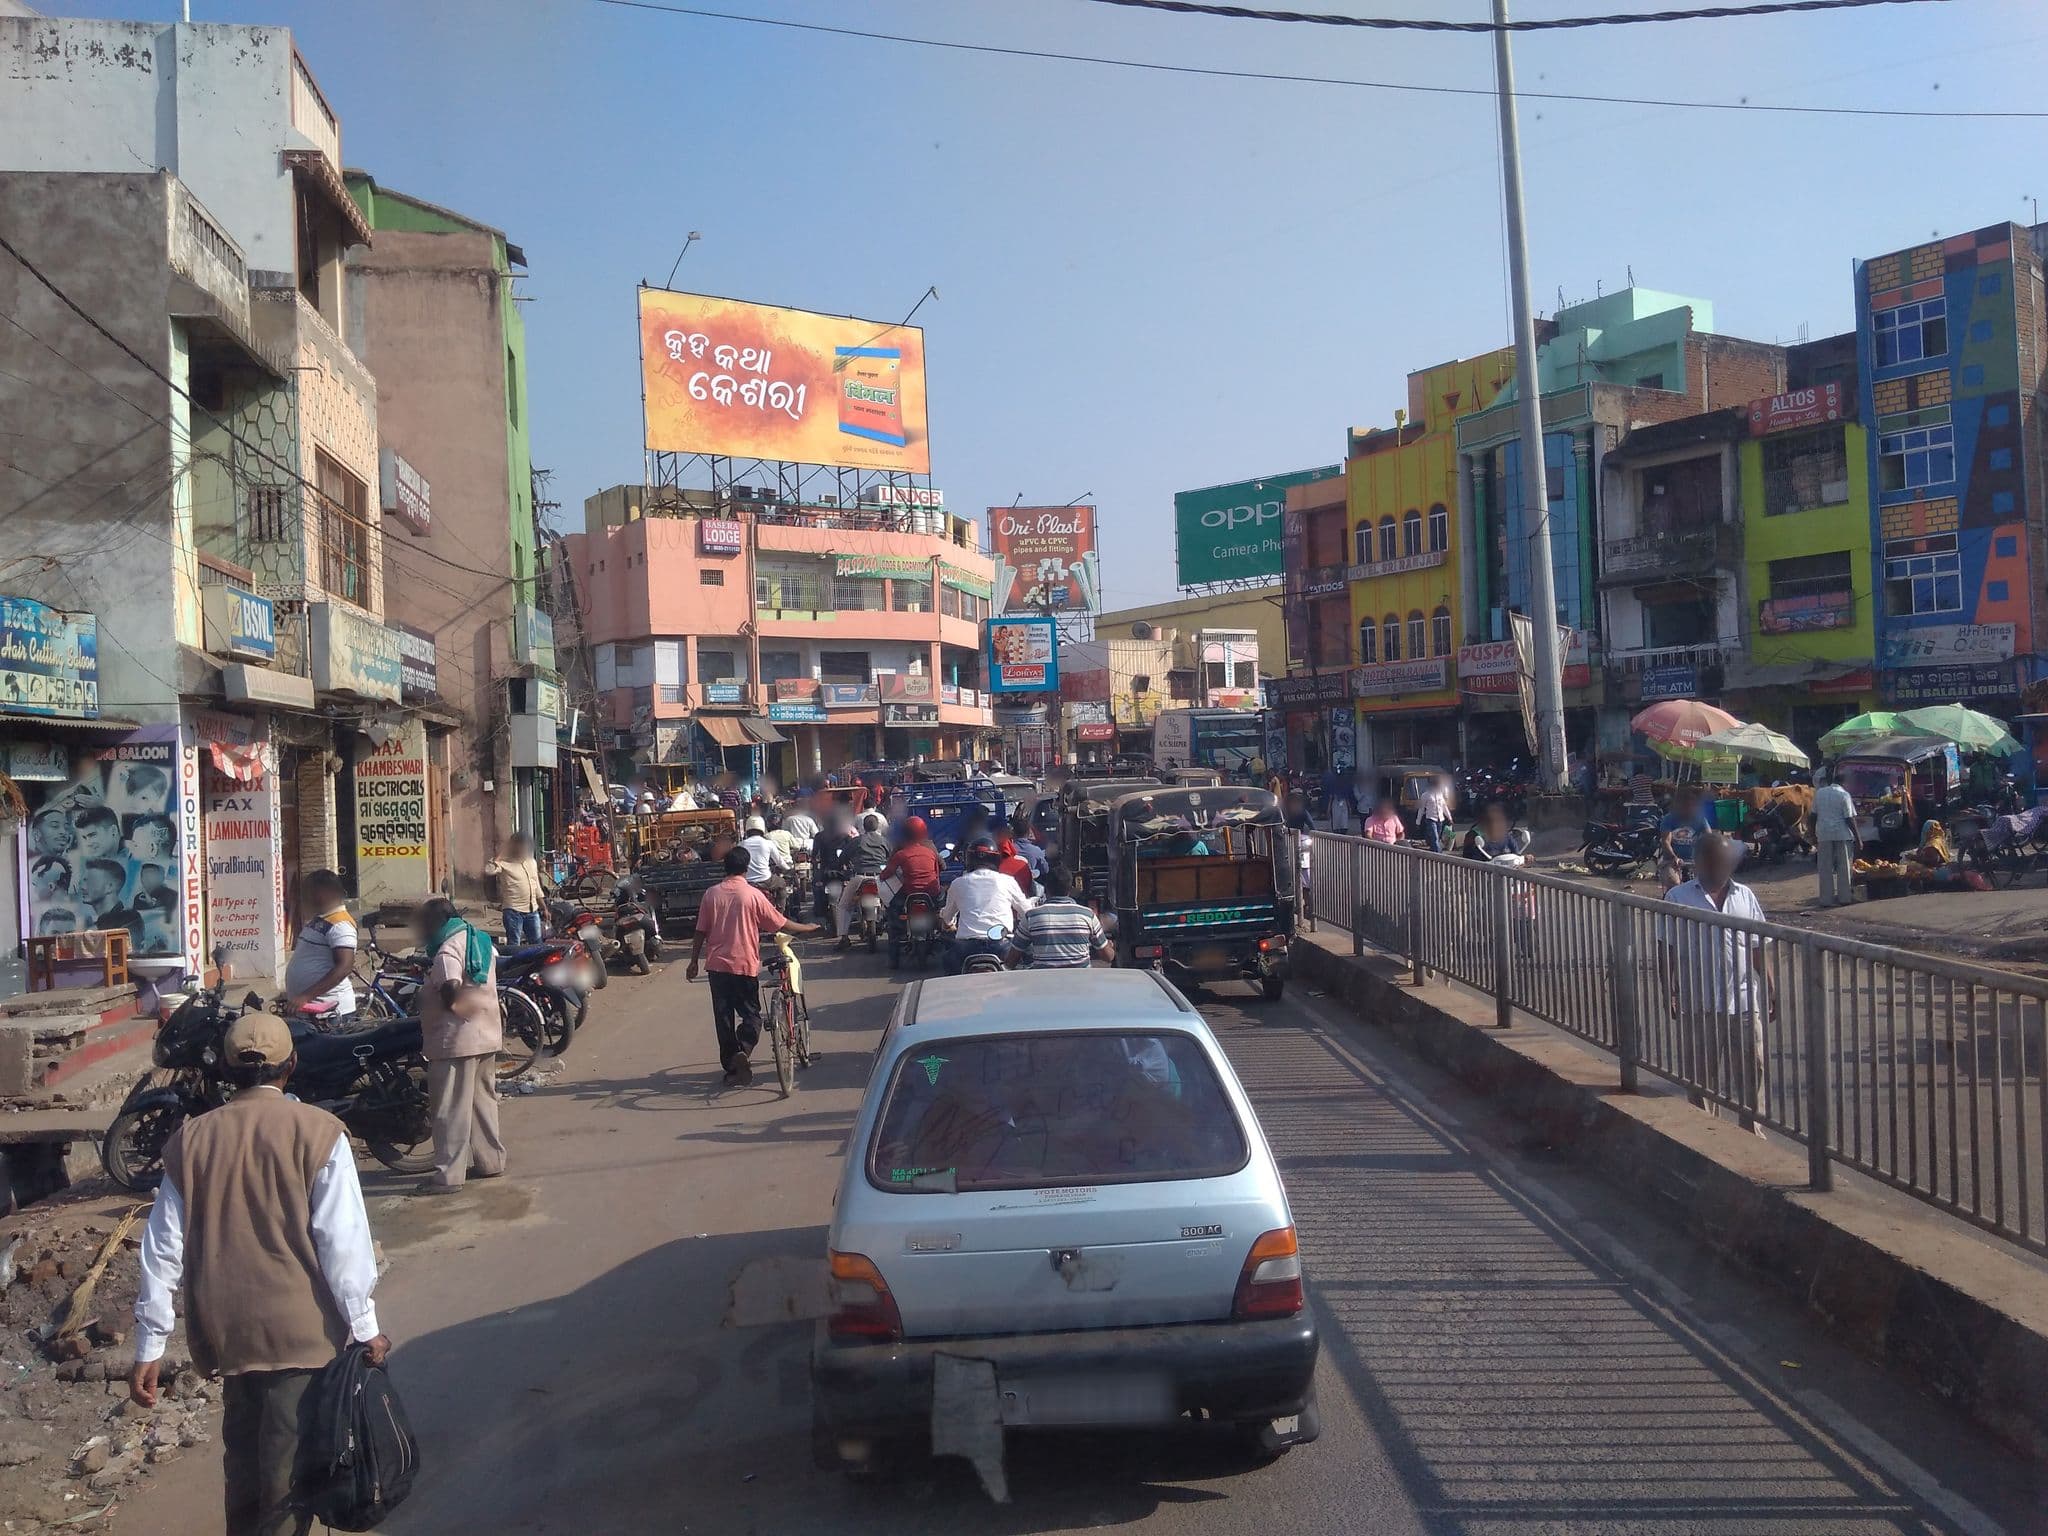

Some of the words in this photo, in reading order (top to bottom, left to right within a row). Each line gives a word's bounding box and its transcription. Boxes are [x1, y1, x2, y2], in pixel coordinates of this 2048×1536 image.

[714, 345, 771, 375] କଥା
[688, 372, 806, 420] କେଶରୀ
[1771, 389, 1815, 412] ALTOS
[881, 487, 941, 504] LODGE
[1201, 501, 1284, 529] opp
[705, 529, 740, 544] LODGE
[1048, 537, 1068, 545] CPVC
[1013, 546, 1033, 555] pipes
[1034, 545, 1048, 553] and
[1049, 545, 1074, 554] fittings
[1212, 542, 1258, 559] Camera
[1309, 581, 1344, 594] TATTOOS
[242, 598, 272, 643] BSNL
[1, 632, 27, 660] Hair
[29, 637, 64, 677] Cutting
[66, 645, 96, 670] Saloon
[1476, 660, 1511, 669] LODGING
[1470, 675, 1497, 689] HOTEL
[1669, 681, 1692, 693] ATM
[1897, 688, 1919, 699] SRI
[1972, 683, 2016, 696] LODGE
[118, 746, 169, 760] SALOON
[356, 760, 424, 777] KHAMBESWARI
[210, 777, 264, 793] XEROX
[358, 780, 424, 798] ELECTRICALS
[183, 745, 197, 850] COLOUR
[213, 799, 253, 812] FAX
[208, 820, 271, 841] LAMINATION
[362, 846, 421, 857] XEROX
[274, 852, 286, 935] XEROX
[211, 897, 224, 908] All
[225, 897, 244, 911] Type
[247, 897, 258, 908] of
[187, 853, 205, 976] XEROX
[1186, 911, 1234, 923] REDDY
[212, 927, 260, 937] VOUCHERS
[1183, 1226, 1204, 1236] 800
[1207, 1225, 1221, 1235] AC
